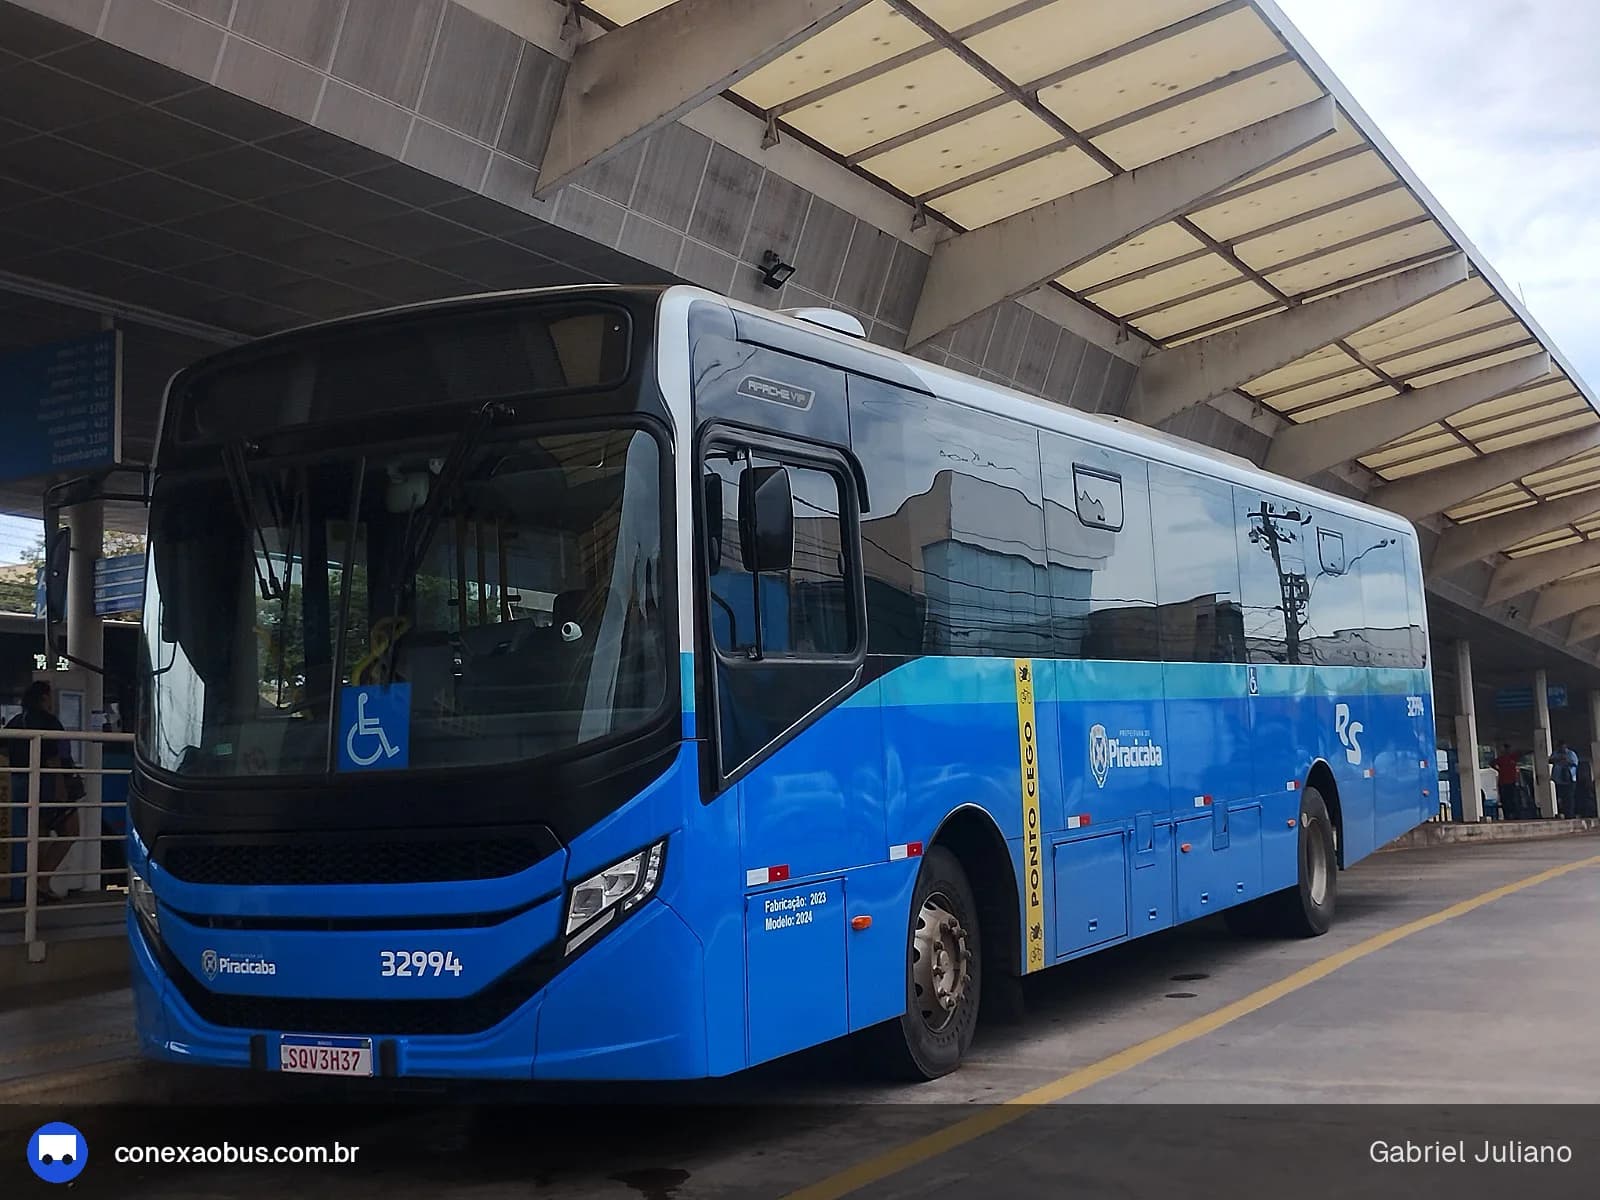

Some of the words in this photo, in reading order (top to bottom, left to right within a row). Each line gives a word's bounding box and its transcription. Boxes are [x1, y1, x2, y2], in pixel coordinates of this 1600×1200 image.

[748, 380, 790, 400] APACHE
[790, 391, 806, 403] VIP
[1335, 703, 1364, 766] RS
[1024, 721, 1035, 798] CEGO
[1108, 738, 1163, 768] Piracicaba
[1028, 807, 1039, 907] PONTO
[765, 896, 807, 913] Fabricação:
[810, 891, 827, 906] 2023
[765, 914, 795, 931] Modelo:
[795, 910, 813, 925] 2024
[219, 957, 276, 975] Piracicaba
[380, 951, 463, 977] 32994
[288, 1048, 361, 1072] SQV3H37
